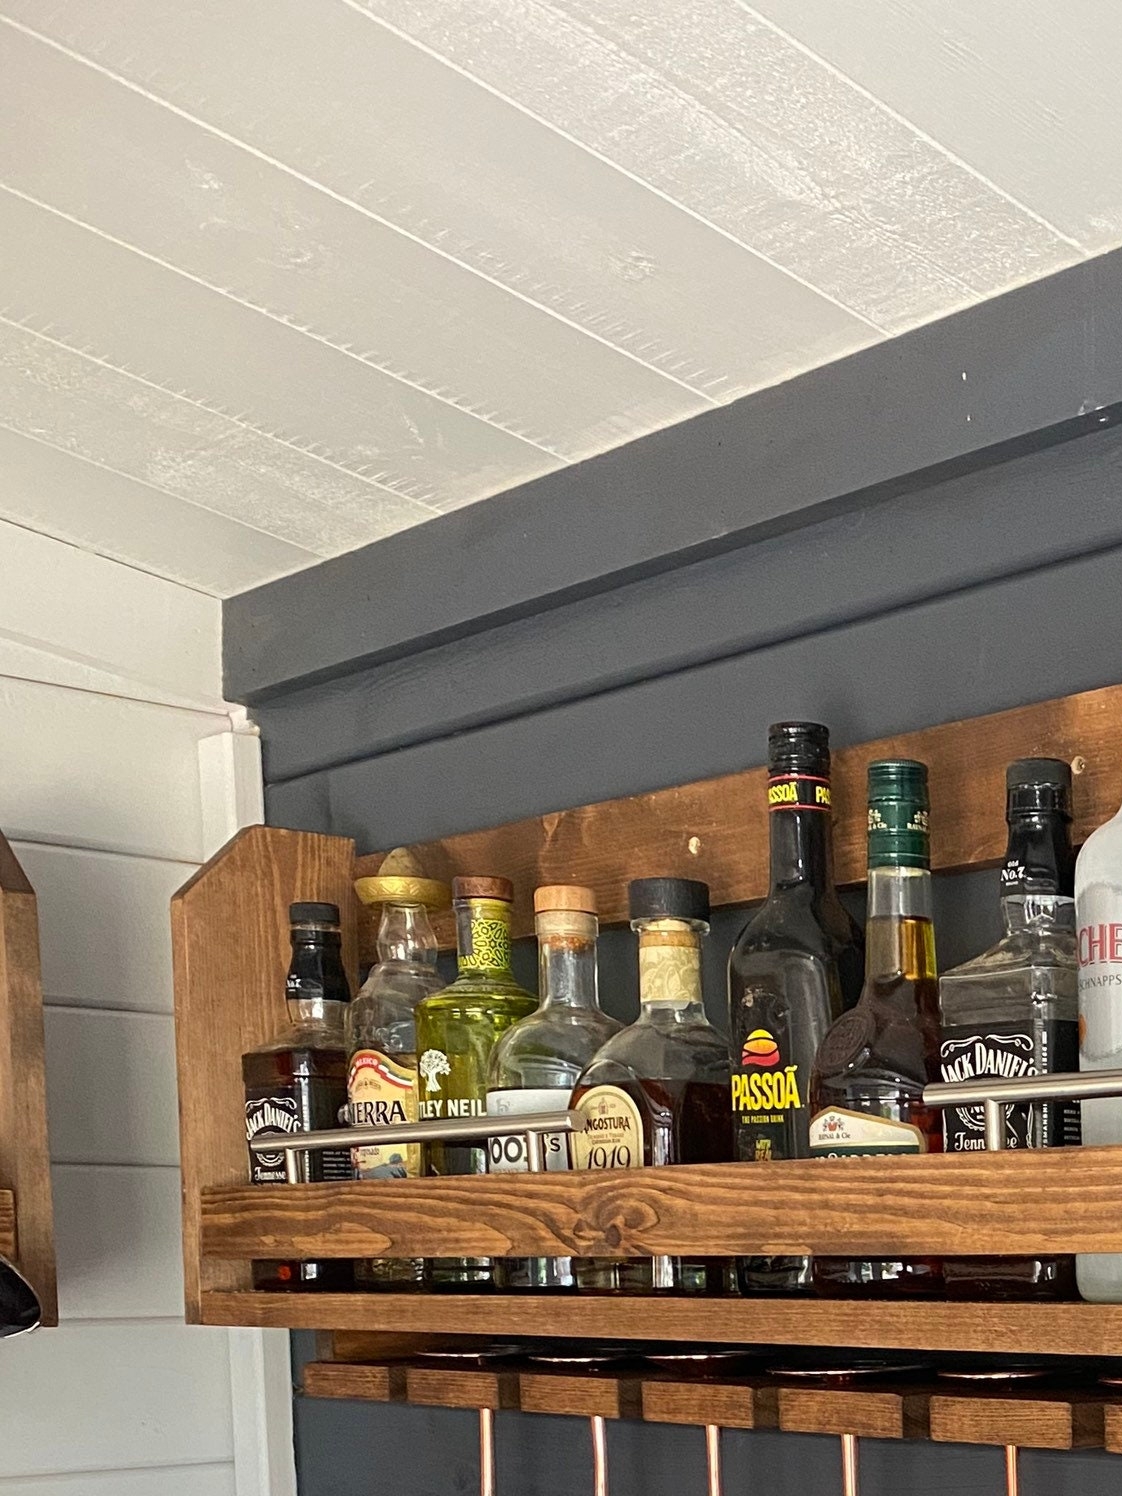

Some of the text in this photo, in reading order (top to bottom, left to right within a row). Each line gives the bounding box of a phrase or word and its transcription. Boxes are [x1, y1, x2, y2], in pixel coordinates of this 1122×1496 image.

[941, 1052, 975, 1082] JACK
[352, 1100, 407, 1126] IERRA
[447, 1099, 487, 1118] NEIL
[246, 1111, 264, 1141] JACK
[584, 1145, 631, 1169] 1919
